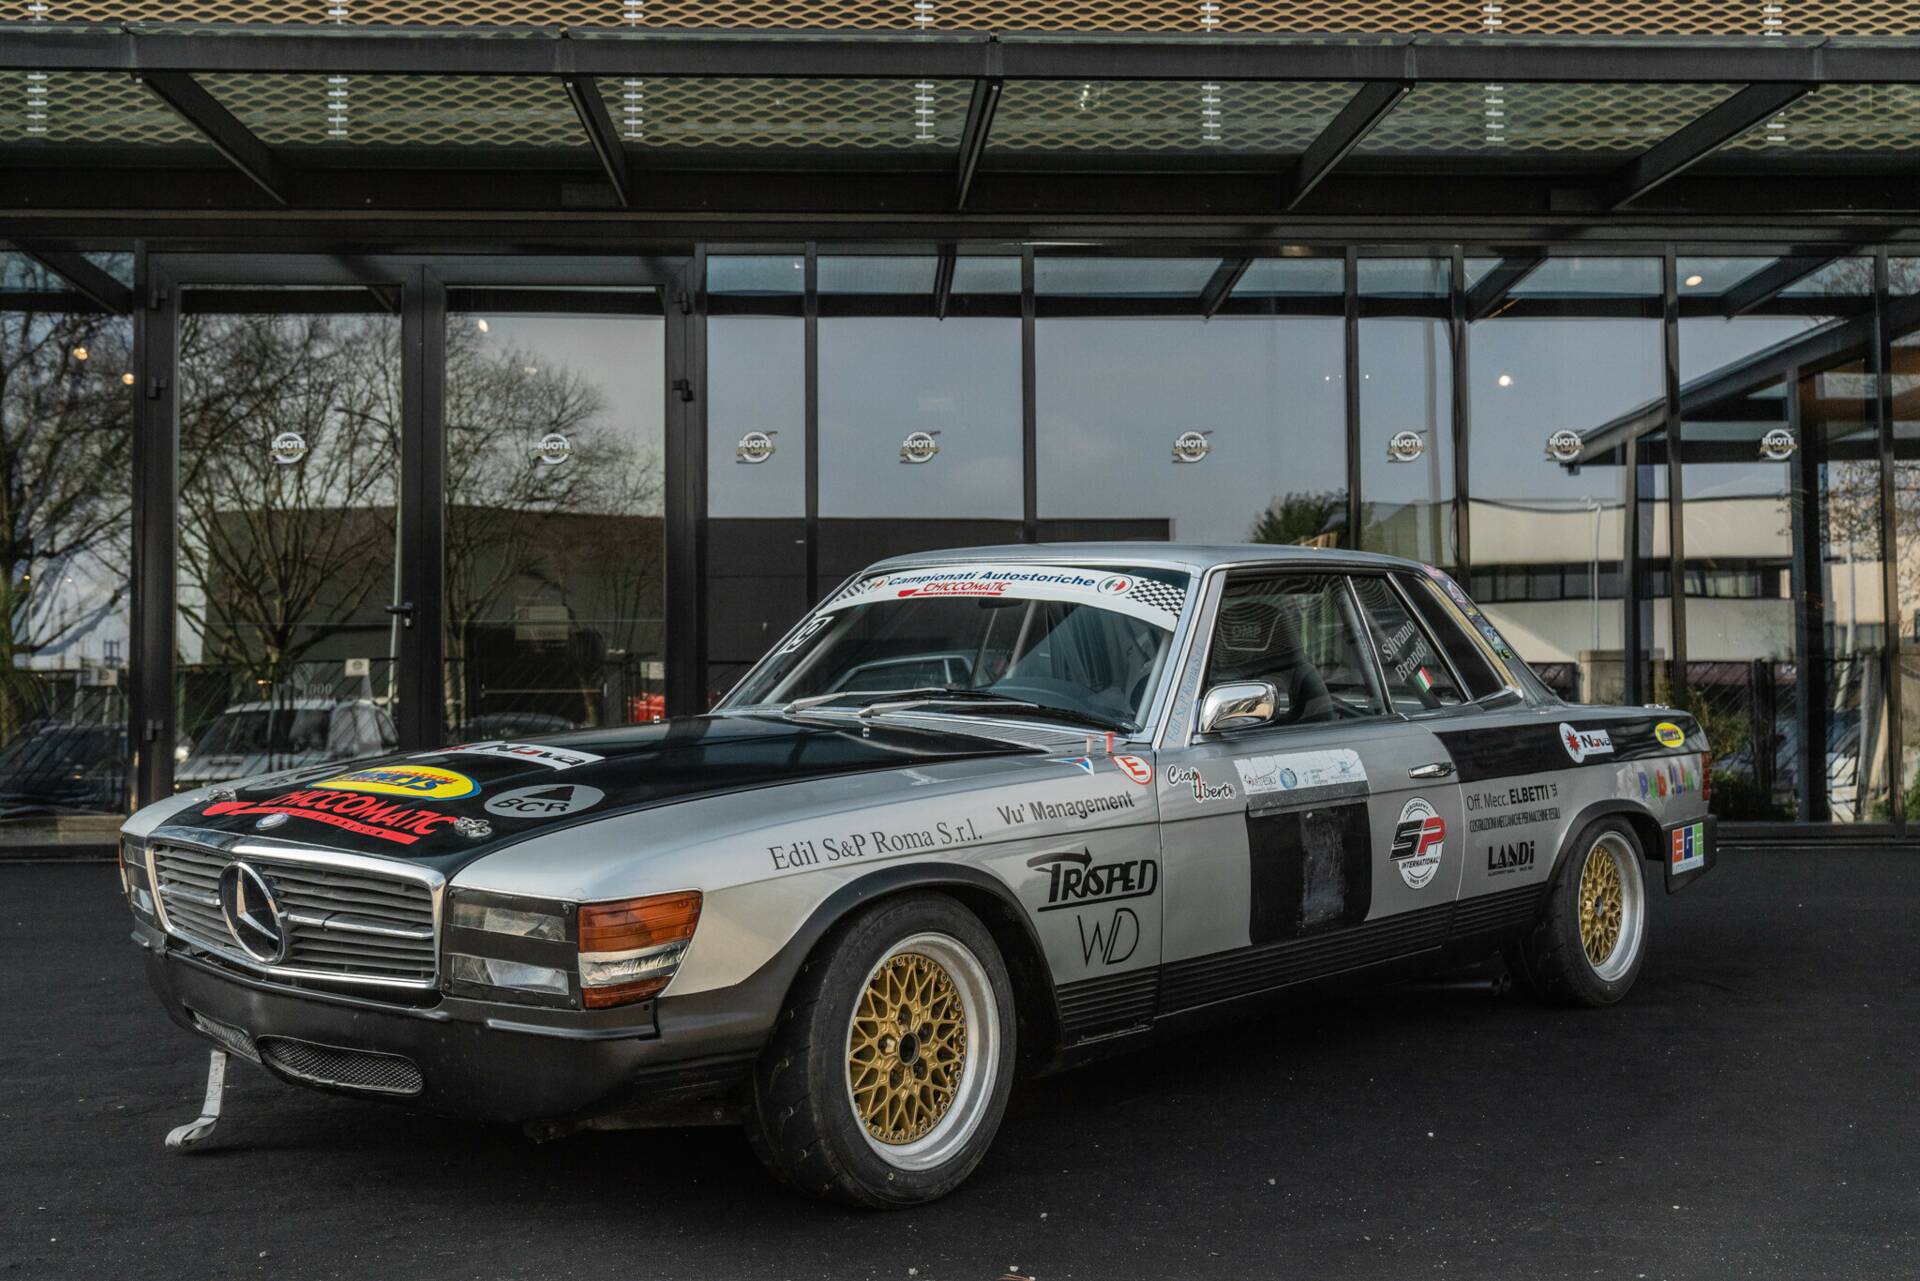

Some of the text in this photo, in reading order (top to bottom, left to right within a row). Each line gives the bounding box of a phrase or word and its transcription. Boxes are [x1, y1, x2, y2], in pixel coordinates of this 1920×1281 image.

[272, 441, 305, 449] RUOTE
[537, 441, 571, 450] RUOTE
[739, 440, 771, 448] RUOTE
[903, 440, 935, 448] RUOTE
[1175, 440, 1208, 448] RUOTE
[1391, 439, 1423, 448] RUOTE
[1550, 437, 1581, 446] RUOTE
[1762, 438, 1794, 446] RUOTE
[888, 571, 1096, 587] Campionati Autostoriche
[923, 581, 1012, 592] CHICCOMATIC
[1382, 620, 1415, 661] Silvano
[1395, 638, 1427, 682] Brandi
[1581, 733, 1611, 748] Nova
[1120, 756, 1147, 776] E
[1168, 765, 1200, 785] Ciao
[492, 797, 570, 813] BCR
[1029, 791, 1135, 819] Management
[1466, 784, 1550, 811] Off. Mecc. ELBETTI
[767, 818, 983, 870] Edil S&P Roma S.r.l.
[1389, 816, 1448, 862] SP
[1402, 857, 1439, 869] INTERNATIONAL
[1077, 907, 1139, 968] WD
